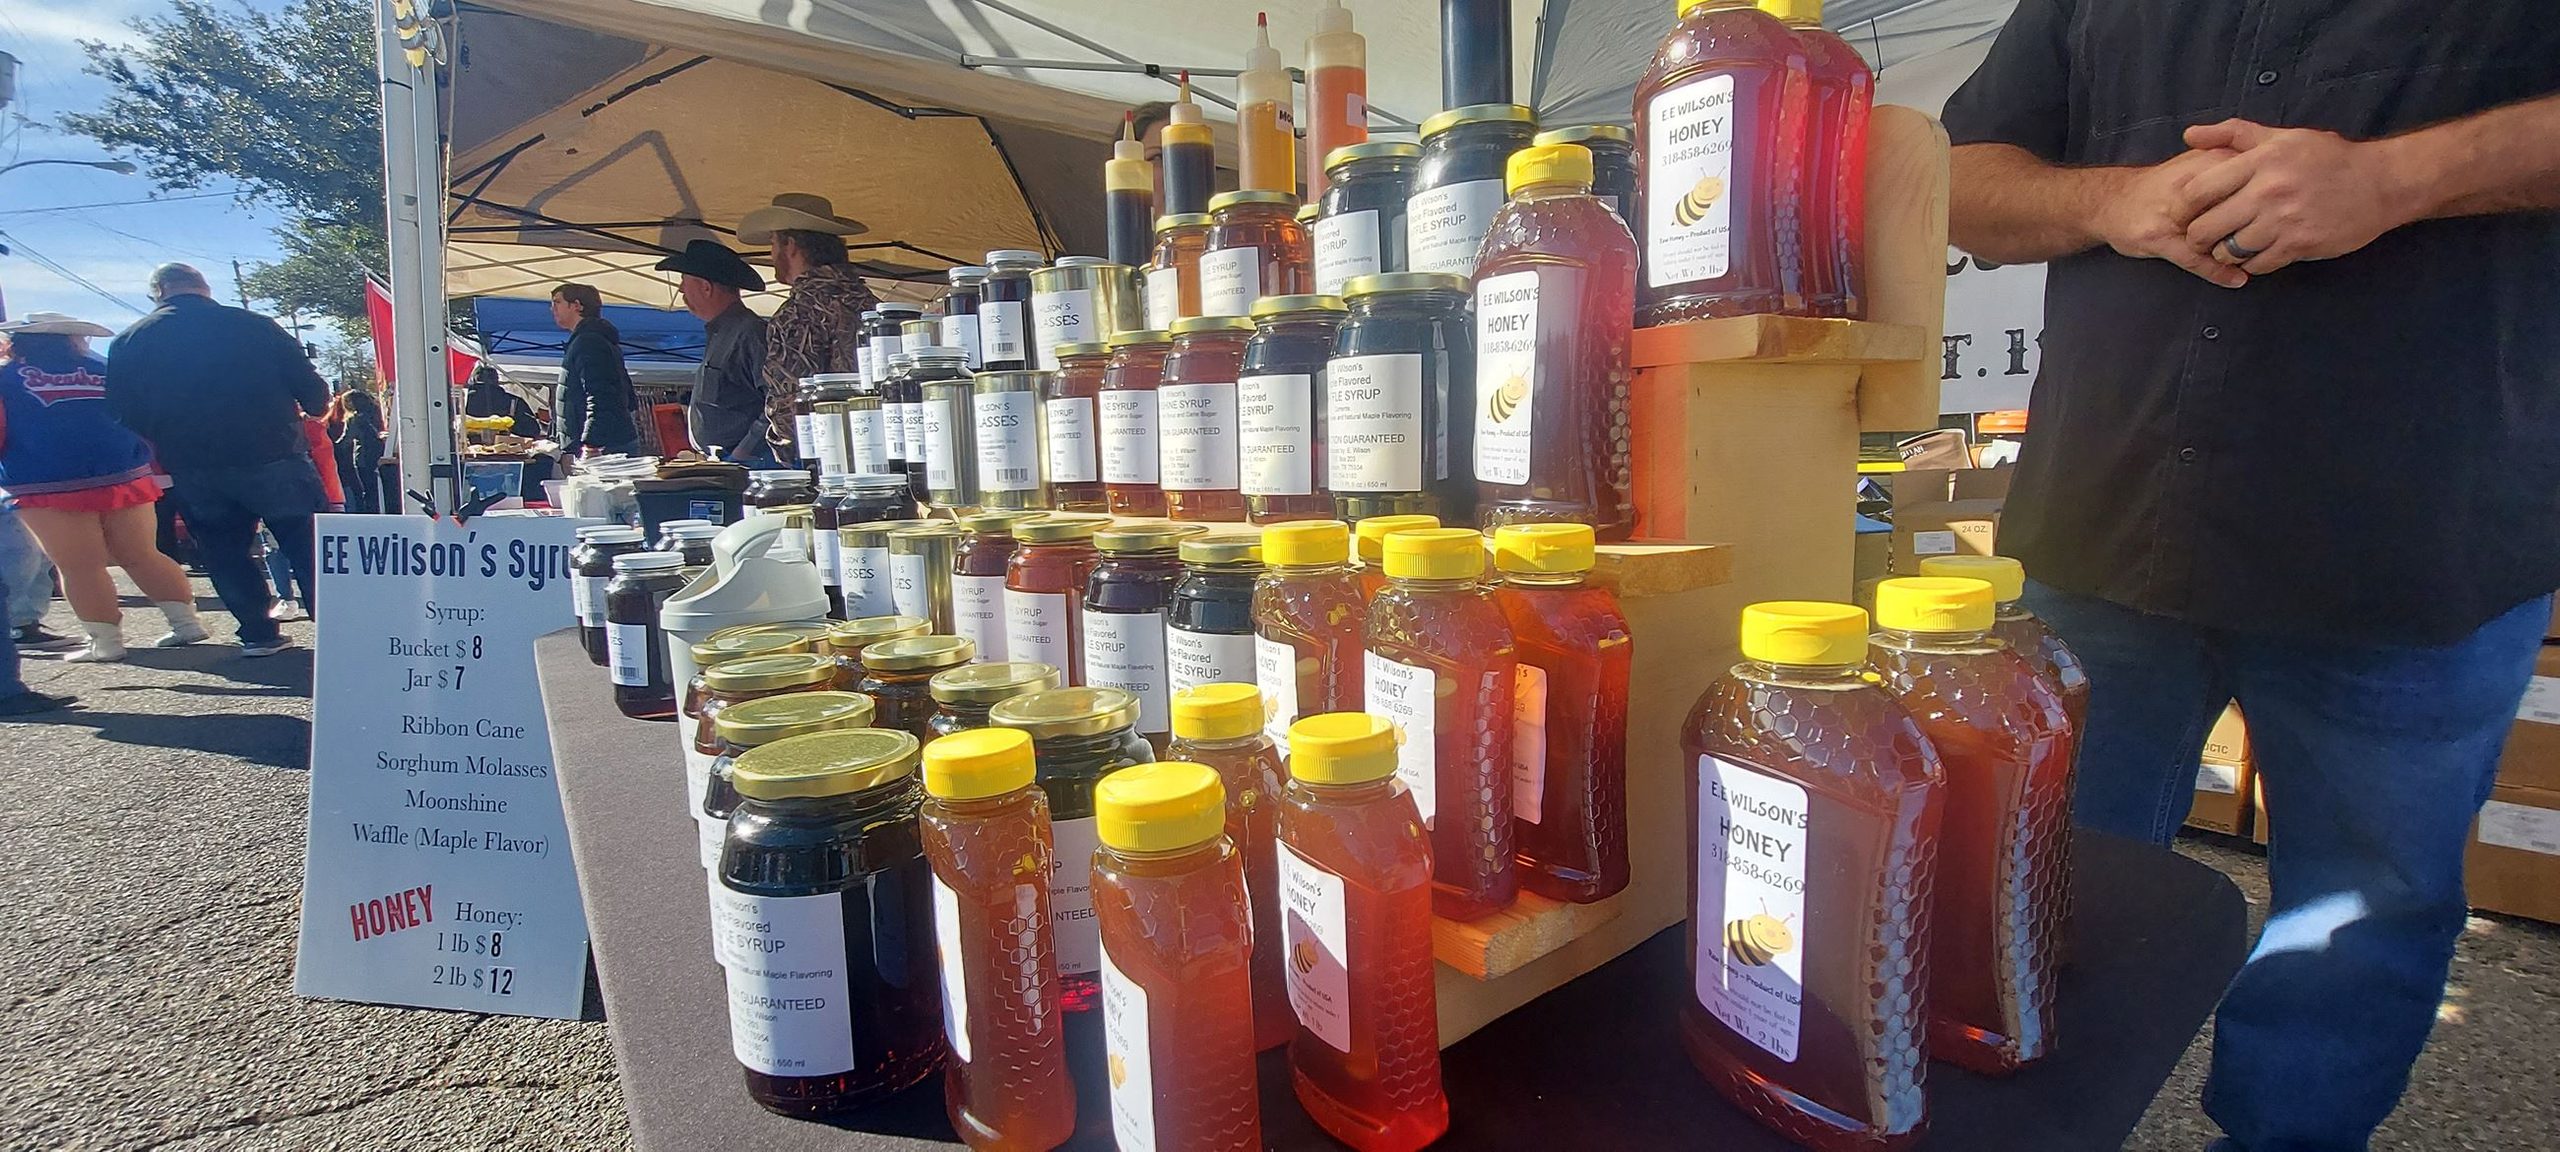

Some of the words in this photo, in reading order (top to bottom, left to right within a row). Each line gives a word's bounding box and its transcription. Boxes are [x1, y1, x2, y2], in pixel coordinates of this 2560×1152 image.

[1677, 91, 1734, 116] WILSON'S
[1669, 117, 1724, 145] HONEY
[1430, 214, 1467, 230] SYRUP
[1322, 239, 1348, 253] SYRUP
[1212, 262, 1238, 273] SYRUP
[1493, 287, 1540, 305] WILSON'S
[1487, 314, 1530, 333] HONEY
[1338, 374, 1371, 386] Flavored
[1180, 399, 1211, 409] SYRUP
[1345, 388, 1381, 401] SYRUP
[1112, 402, 1138, 410] SYRUP
[1247, 405, 1274, 416] SYRUP
[1382, 411, 1412, 420] Flavoring
[1172, 427, 1220, 436] GUARANTEED
[1344, 434, 1406, 444] GUARANTEED
[1247, 444, 1295, 453] GUARANTEED
[322, 535, 350, 574] EE
[357, 531, 497, 578] Wilson's
[961, 587, 985, 596] SYRUP
[425, 601, 485, 626] Syrup:
[1015, 607, 1042, 617] SYRUP
[388, 636, 450, 658] Bucket
[1095, 641, 1126, 652] SYRUP
[1178, 648, 1212, 664] Flavored
[402, 667, 433, 692] Jar
[1184, 664, 1222, 679] SYRUP
[1383, 660, 1414, 681] Wilson's
[1375, 677, 1408, 699] HONEY
[401, 715, 468, 737] Ribbon
[476, 719, 525, 740] Cane
[376, 751, 459, 778] Sorghum
[465, 755, 548, 779] Molasses
[404, 789, 507, 813] Moonshine
[1731, 790, 1809, 829] WILSON'S
[352, 822, 409, 846] Waffle
[414, 827, 478, 854] (Maple
[484, 831, 550, 859] Flavor)
[1720, 816, 1792, 862] HONEY
[1711, 843, 1806, 895] 318-858-6269
[1287, 882, 1317, 916] HONEY
[350, 884, 433, 942] HONEY
[455, 901, 523, 932] Honey:
[437, 933, 444, 952] 1
[451, 933, 470, 954] lb
[737, 935, 786, 954] SYRUP
[433, 965, 443, 985] 2
[450, 966, 467, 987] lb
[763, 969, 788, 980] Maple
[790, 968, 833, 981] Flavoring
[1746, 974, 1773, 995] Product
[1775, 990, 1784, 1000] of
[741, 990, 826, 1011] GUARANTEED
[1758, 1031, 1767, 1046] 2
[1772, 1037, 1791, 1058] lbs
